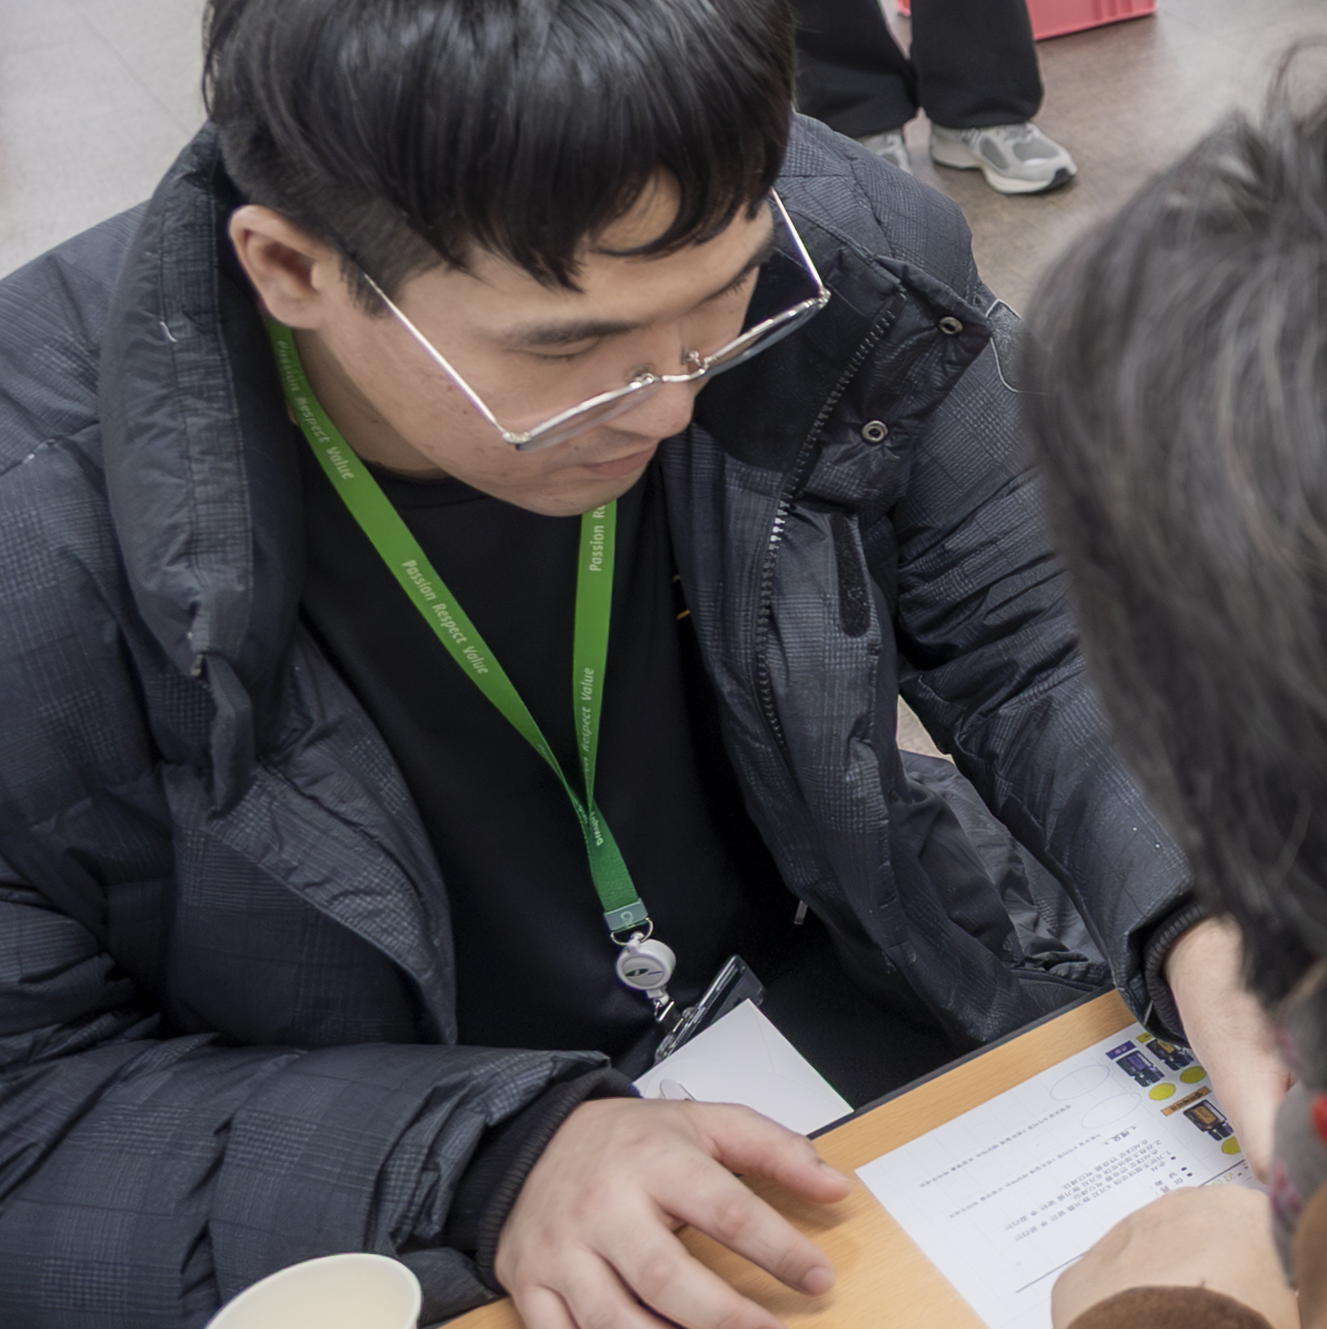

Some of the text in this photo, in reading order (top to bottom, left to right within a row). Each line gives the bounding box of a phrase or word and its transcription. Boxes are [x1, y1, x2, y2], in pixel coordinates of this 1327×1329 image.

[294, 397, 330, 445] Respect
[326, 445, 356, 481] Value
[588, 524, 605, 571] Passion
[402, 559, 489, 676] Passion Respect Value
[579, 667, 595, 700] Value
[577, 706, 594, 752] Respect
